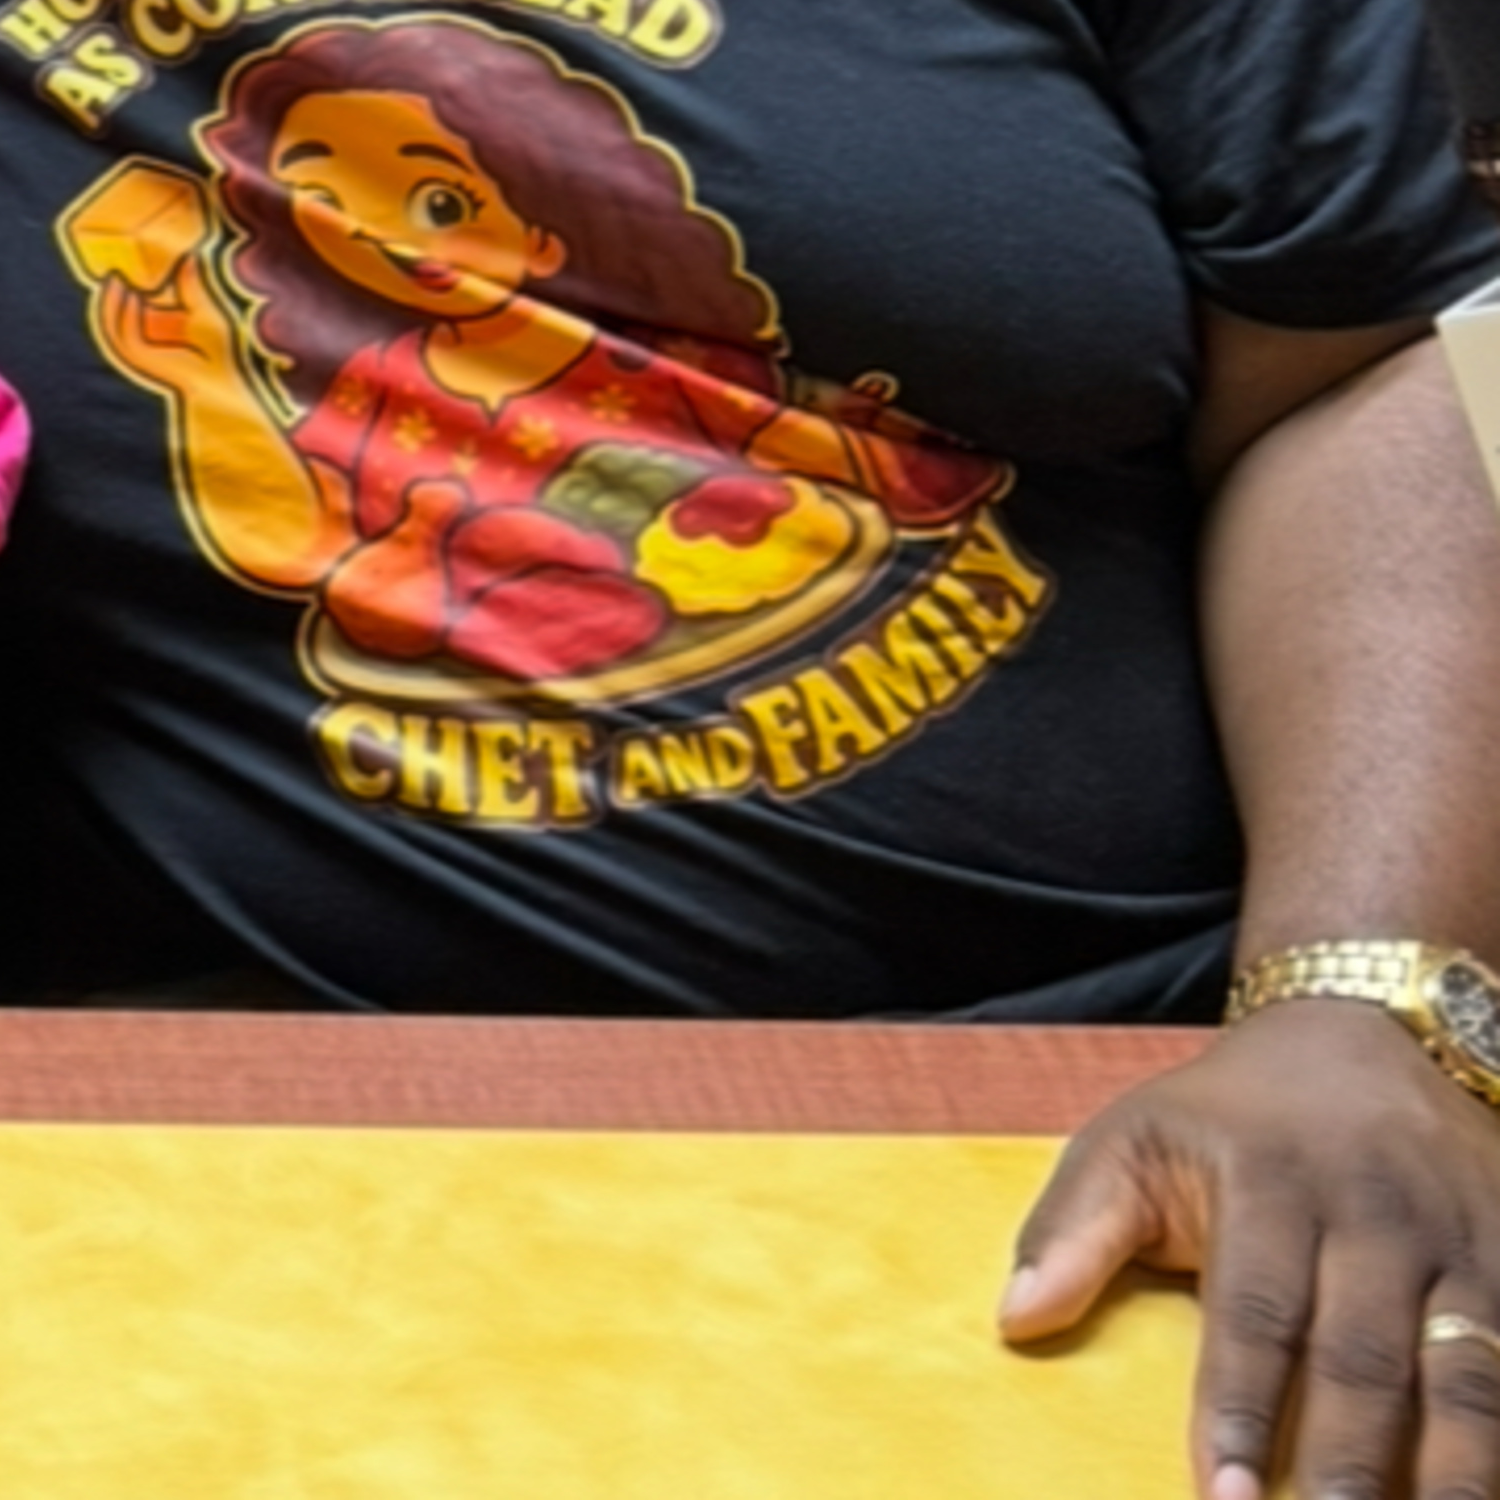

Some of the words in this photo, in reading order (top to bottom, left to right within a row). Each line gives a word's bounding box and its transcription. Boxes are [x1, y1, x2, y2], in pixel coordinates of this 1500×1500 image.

[44, 32, 144, 131] AS
[317, 700, 596, 822] CHET
[614, 724, 758, 804] AND
[740, 506, 1049, 792] FAMILY
